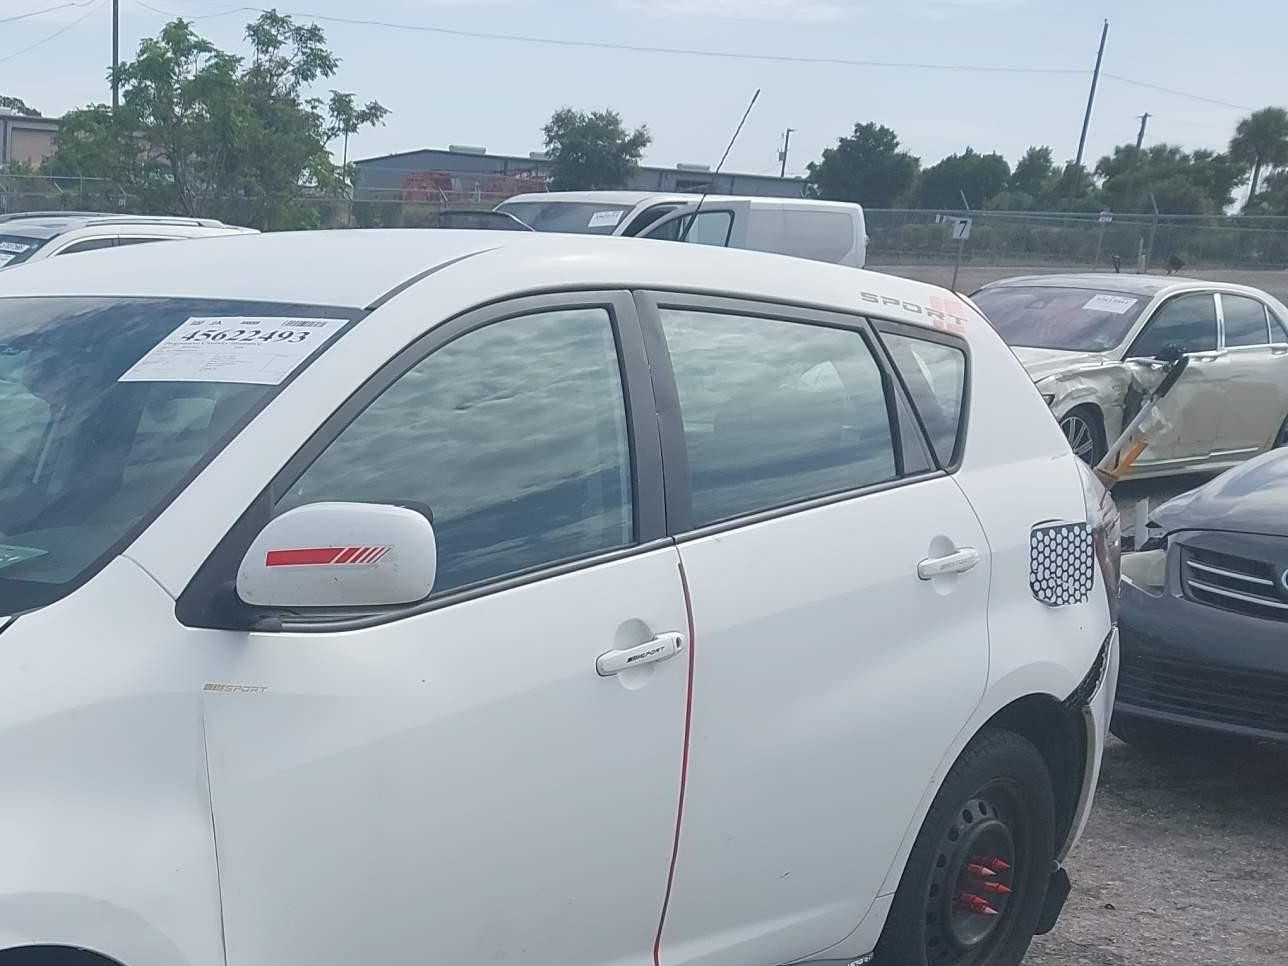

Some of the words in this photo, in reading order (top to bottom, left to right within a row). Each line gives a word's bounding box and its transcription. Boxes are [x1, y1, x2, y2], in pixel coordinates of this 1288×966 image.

[959, 220, 968, 237] 7
[861, 291, 968, 324] SPORT
[182, 329, 311, 343] 45622493
[224, 685, 268, 693] SPORT
